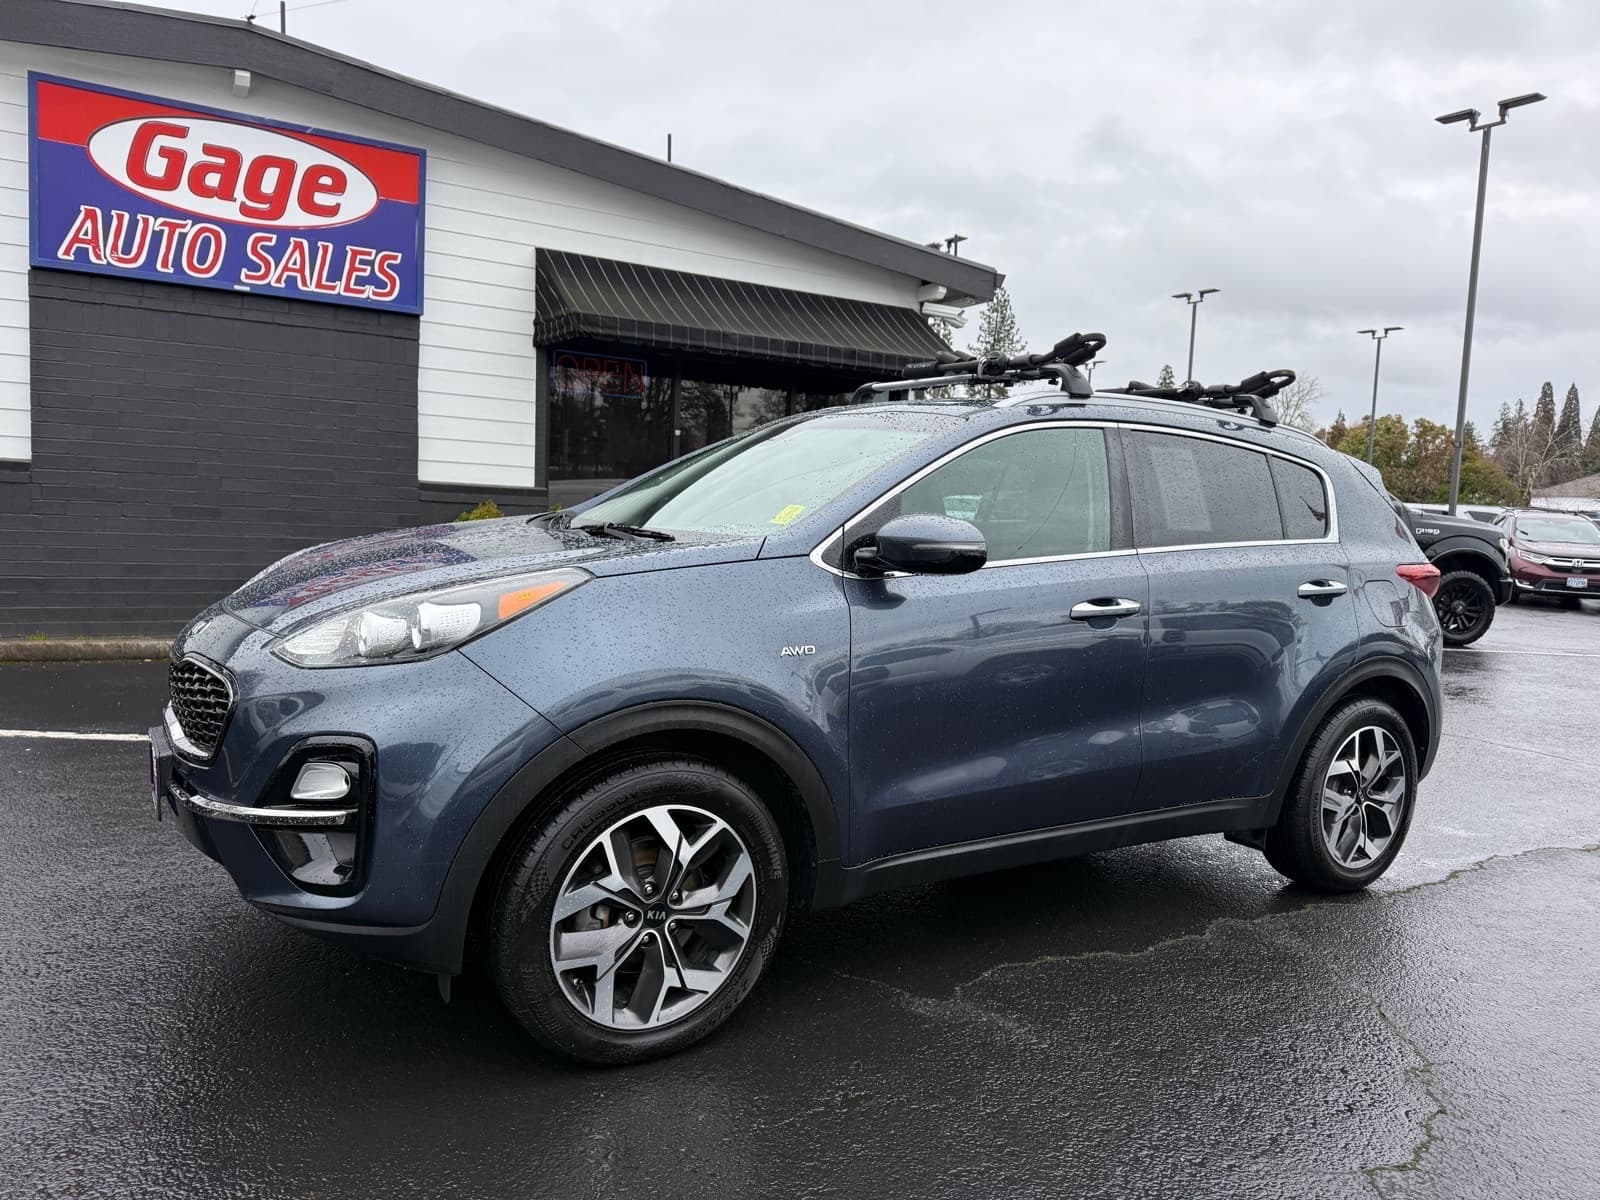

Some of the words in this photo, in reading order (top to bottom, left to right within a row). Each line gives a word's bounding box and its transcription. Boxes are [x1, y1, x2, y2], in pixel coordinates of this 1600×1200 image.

[126, 120, 348, 220] Gage
[57, 205, 226, 278] AUTO
[241, 233, 402, 302] SALES
[557, 353, 643, 394] OPEN
[780, 645, 816, 657] AWD
[647, 910, 666, 920] KIA
